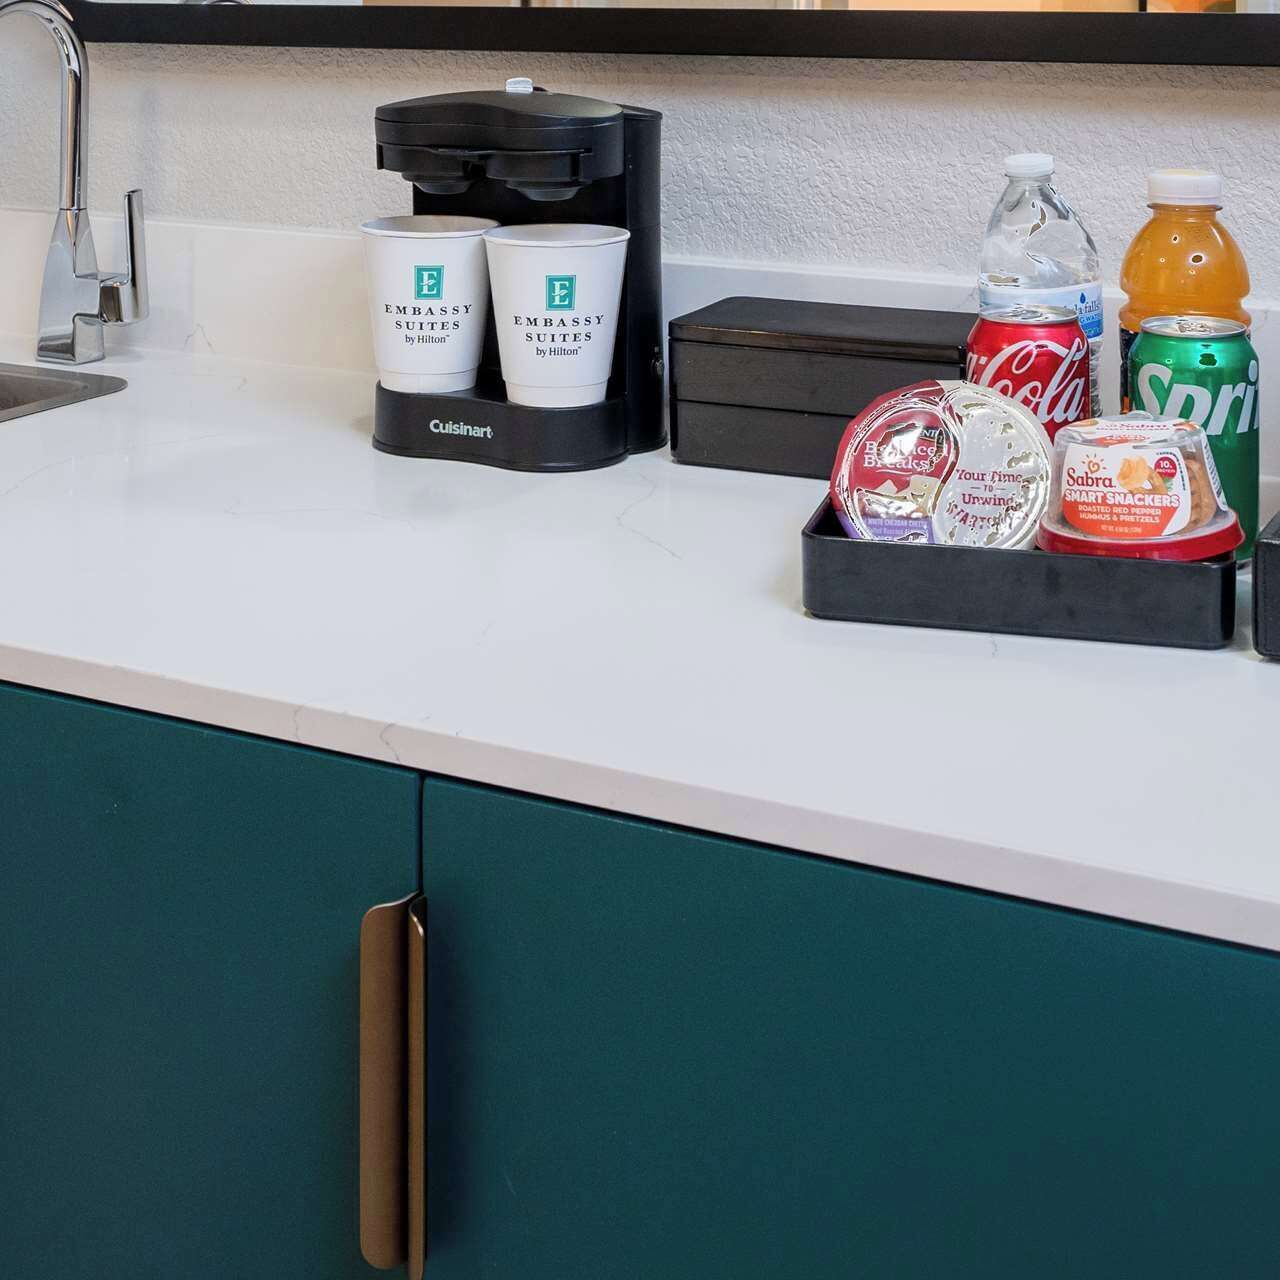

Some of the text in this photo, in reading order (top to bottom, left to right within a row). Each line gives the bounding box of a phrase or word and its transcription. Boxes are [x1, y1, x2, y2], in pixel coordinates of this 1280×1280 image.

[384, 303, 472, 316] EMBASSY
[395, 320, 460, 331] SUITES
[513, 314, 604, 328] EMBASSY
[405, 334, 416, 345] by
[525, 332, 592, 343] SUITES
[536, 347, 547, 358] by
[429, 419, 494, 439] Cuisinart
[956, 469, 987, 480] Your
[1066, 467, 1114, 489] Sabra
[1064, 488, 1181, 508] SMART SNACKERS
[1078, 505, 1111, 513] ROASTED
[1113, 506, 1129, 514] RED
